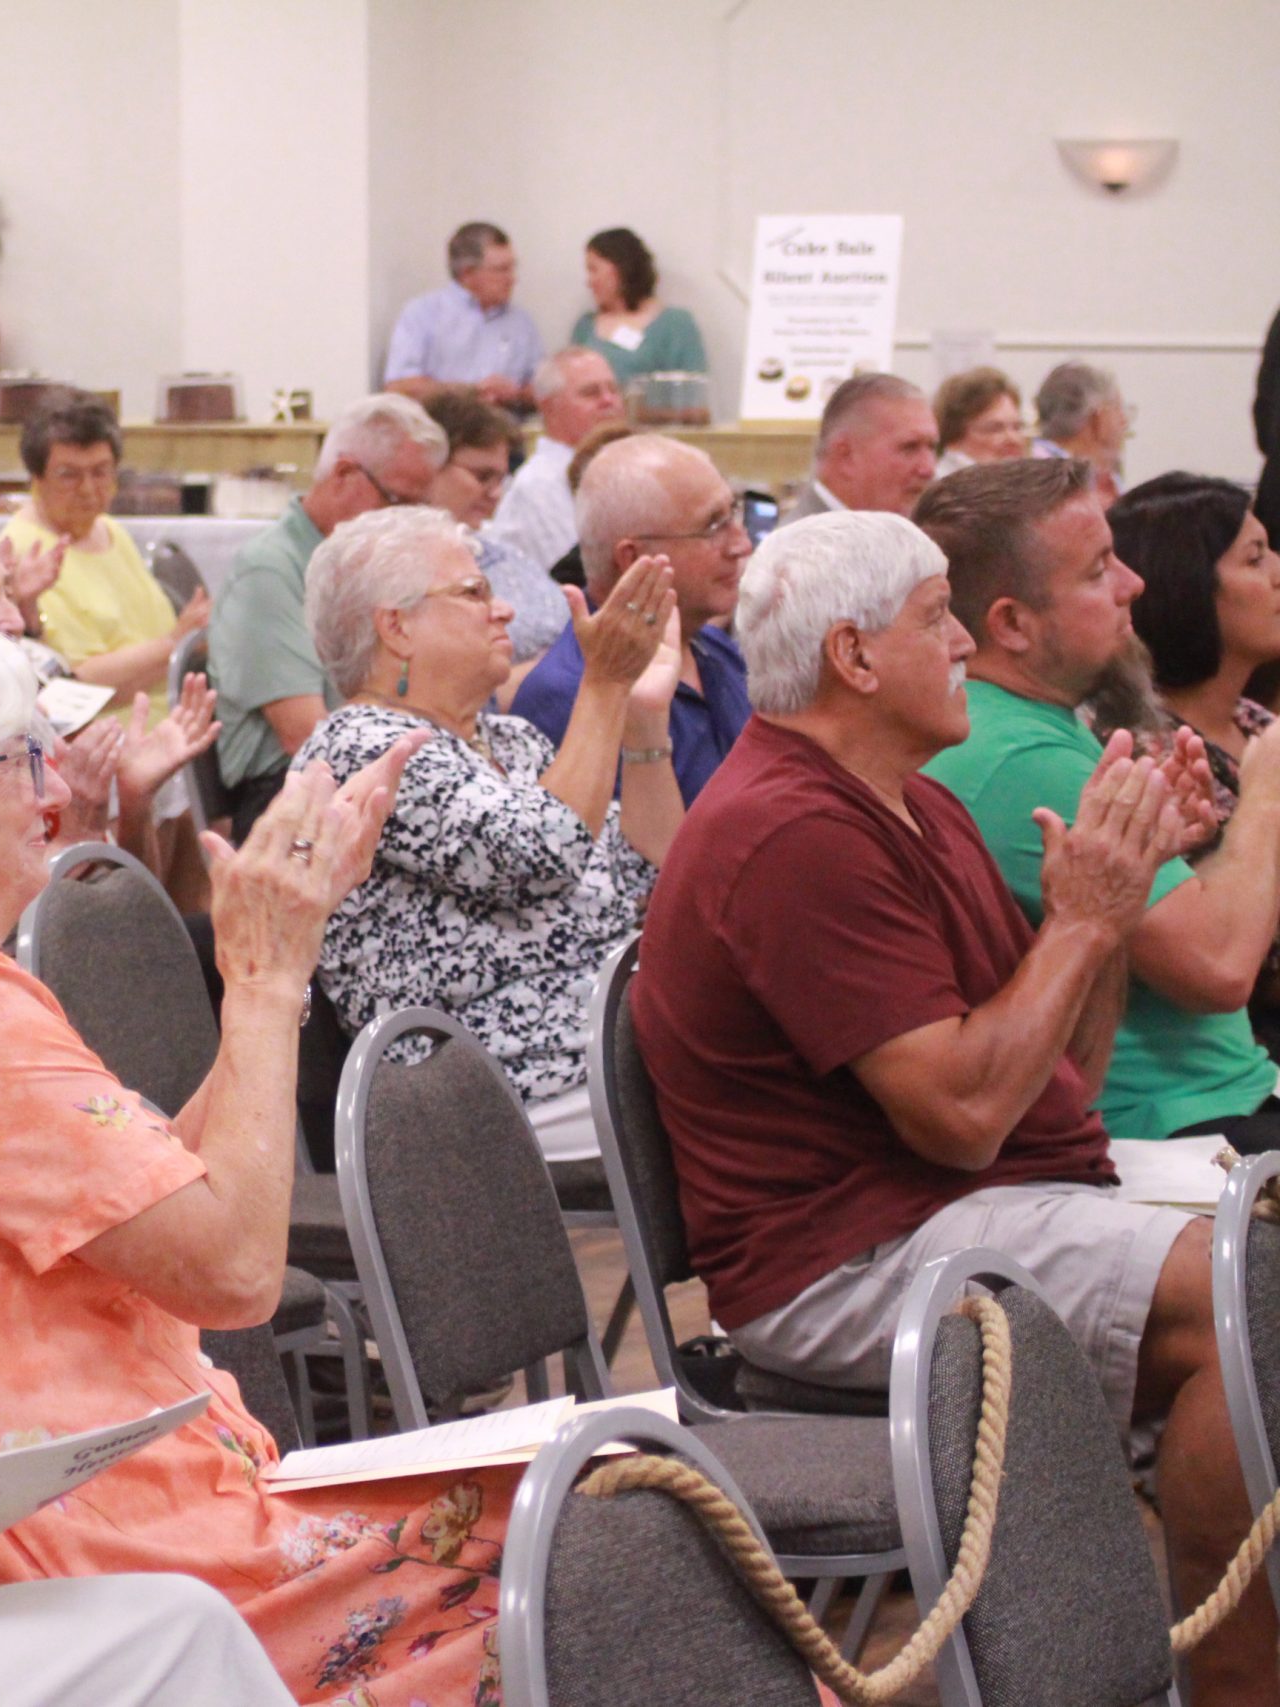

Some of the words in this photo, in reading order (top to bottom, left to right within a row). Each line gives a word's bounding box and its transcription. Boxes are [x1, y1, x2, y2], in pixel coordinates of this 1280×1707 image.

[782, 241, 827, 256] Cake
[837, 240, 875, 256] Sale
[764, 270, 813, 284] Silent
[821, 270, 888, 284] Auction
